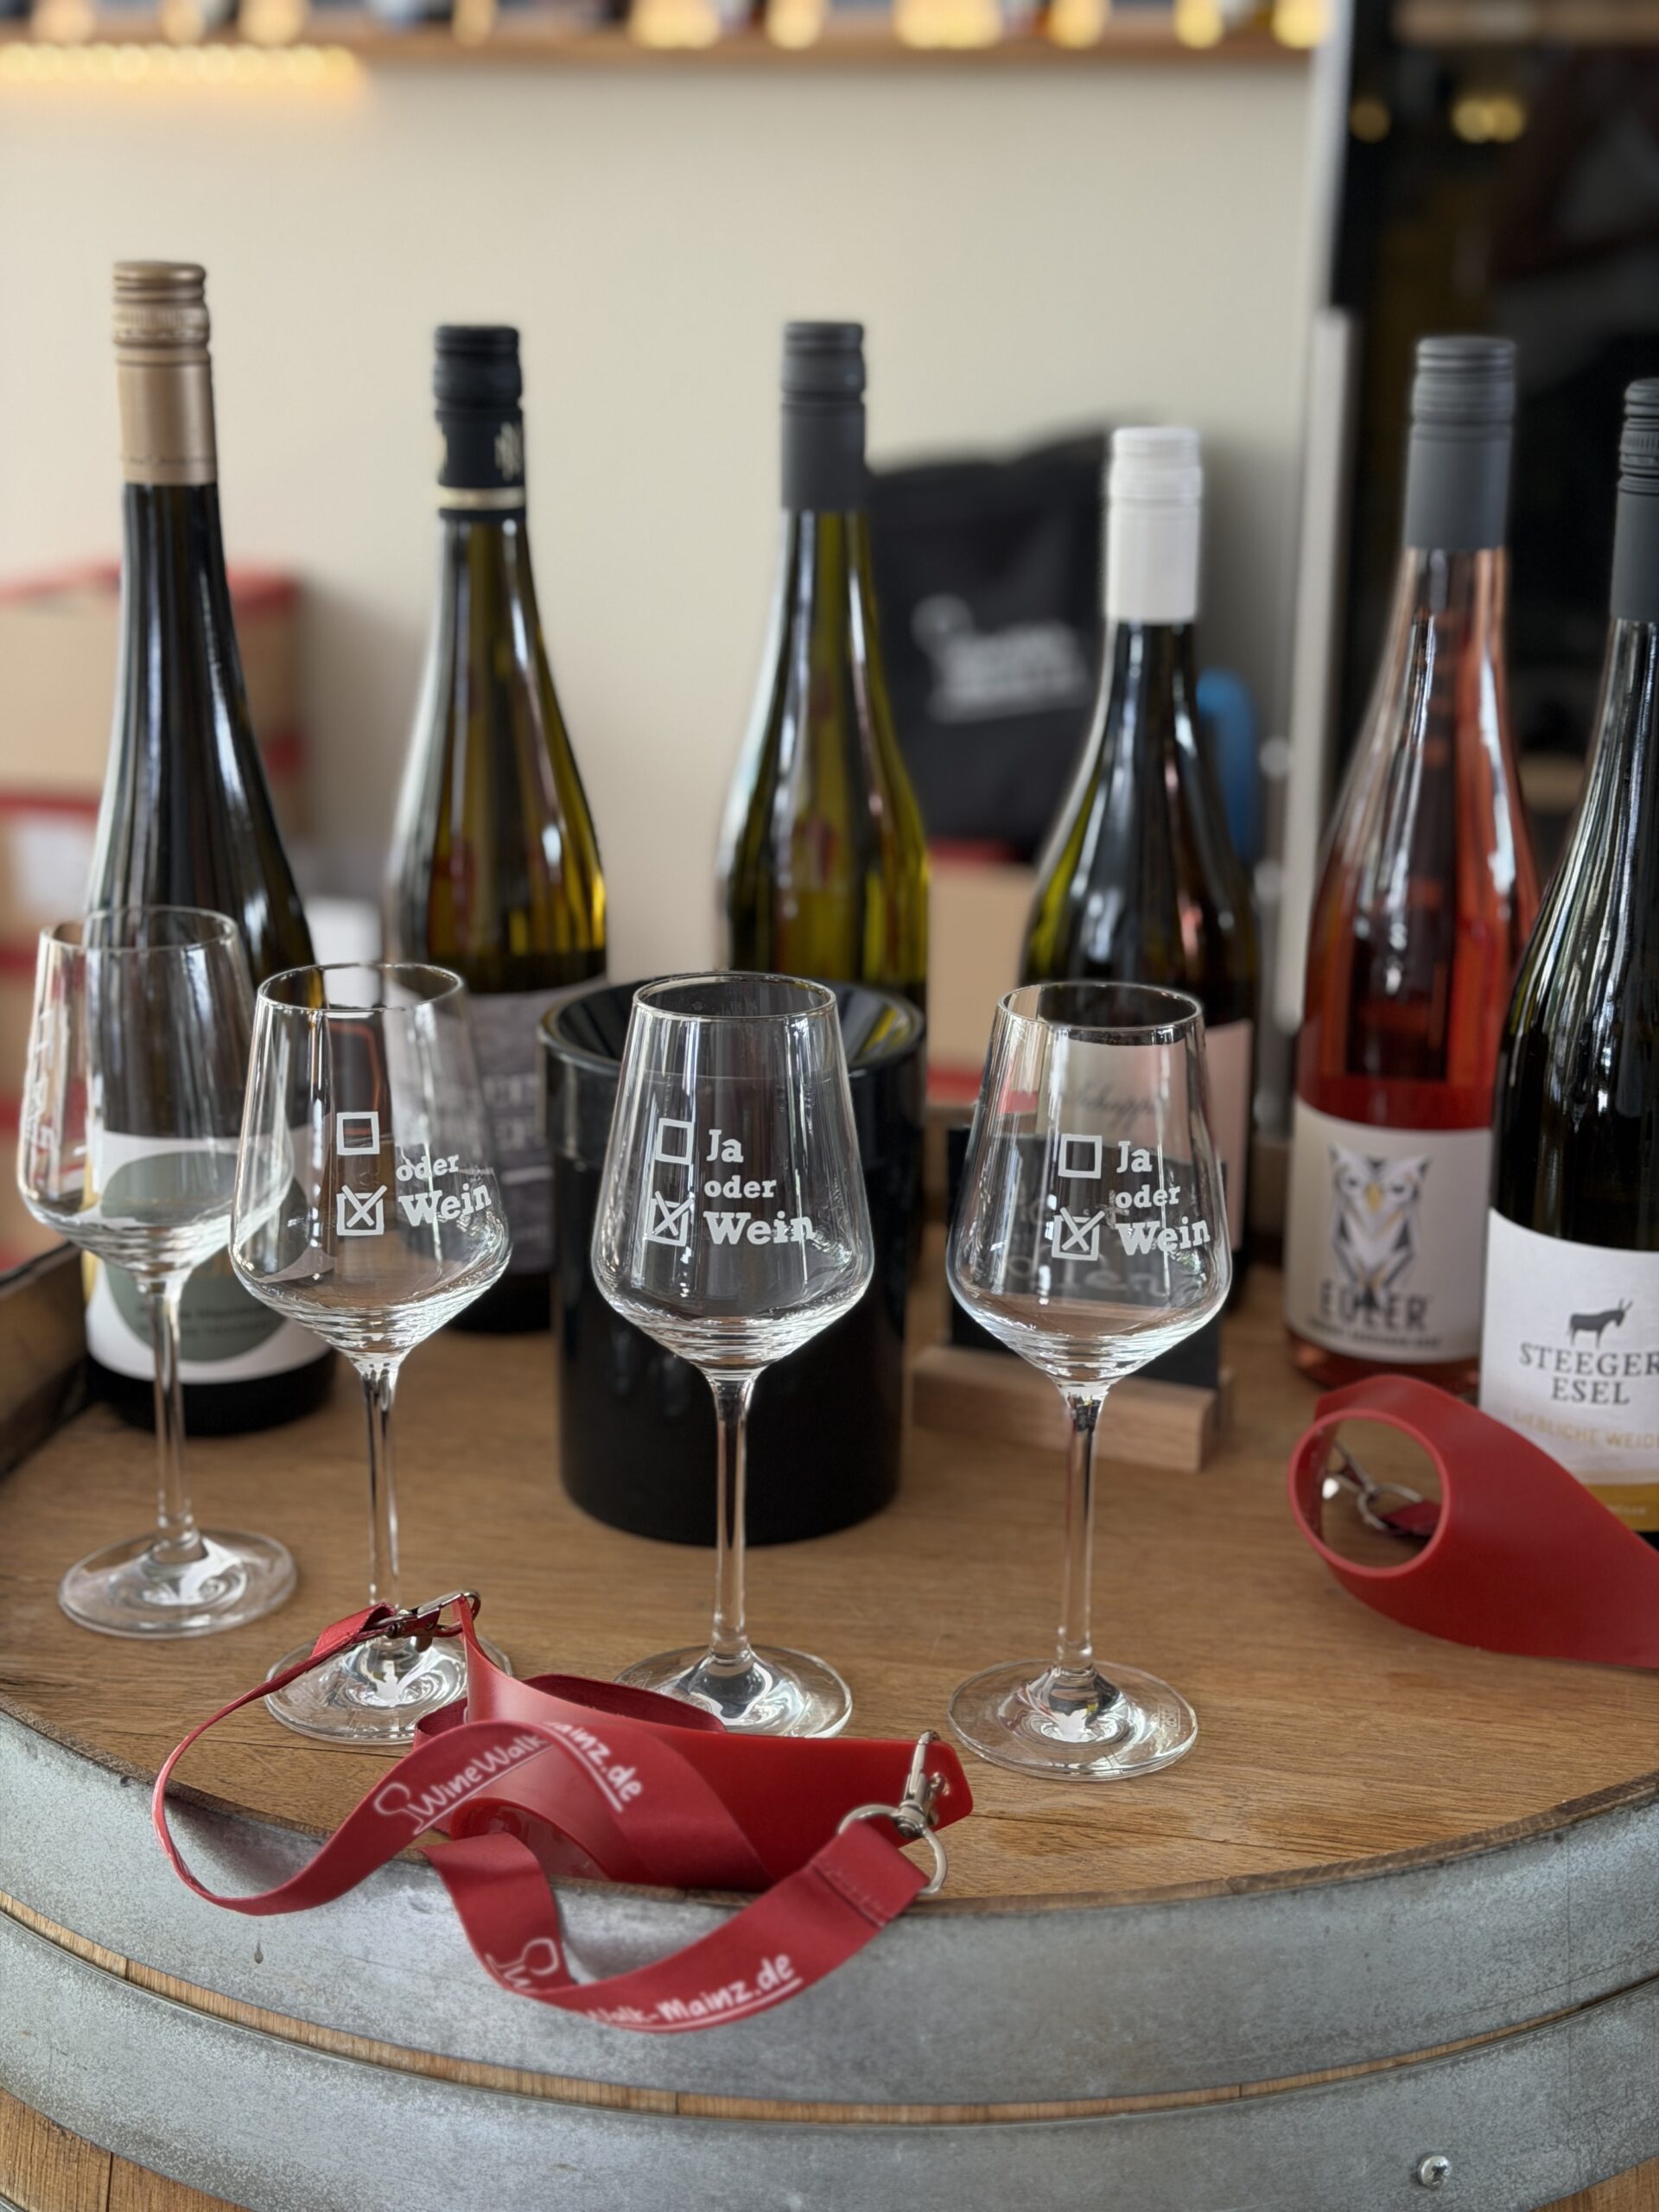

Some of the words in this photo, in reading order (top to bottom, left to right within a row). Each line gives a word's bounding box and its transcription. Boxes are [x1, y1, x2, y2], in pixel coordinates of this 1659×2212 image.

[706, 1128, 744, 1163] Ja
[1116, 1141, 1153, 1173] Ja
[396, 1154, 459, 1181] oder
[704, 1175, 777, 1198] oder
[1115, 1185, 1180, 1209] oder
[397, 1183, 492, 1227] Wein
[703, 1211, 817, 1245] Wein
[1115, 1216, 1211, 1255] Wein
[1519, 1342, 1659, 1378] STEEGER
[1551, 1377, 1630, 1406] ESEL
